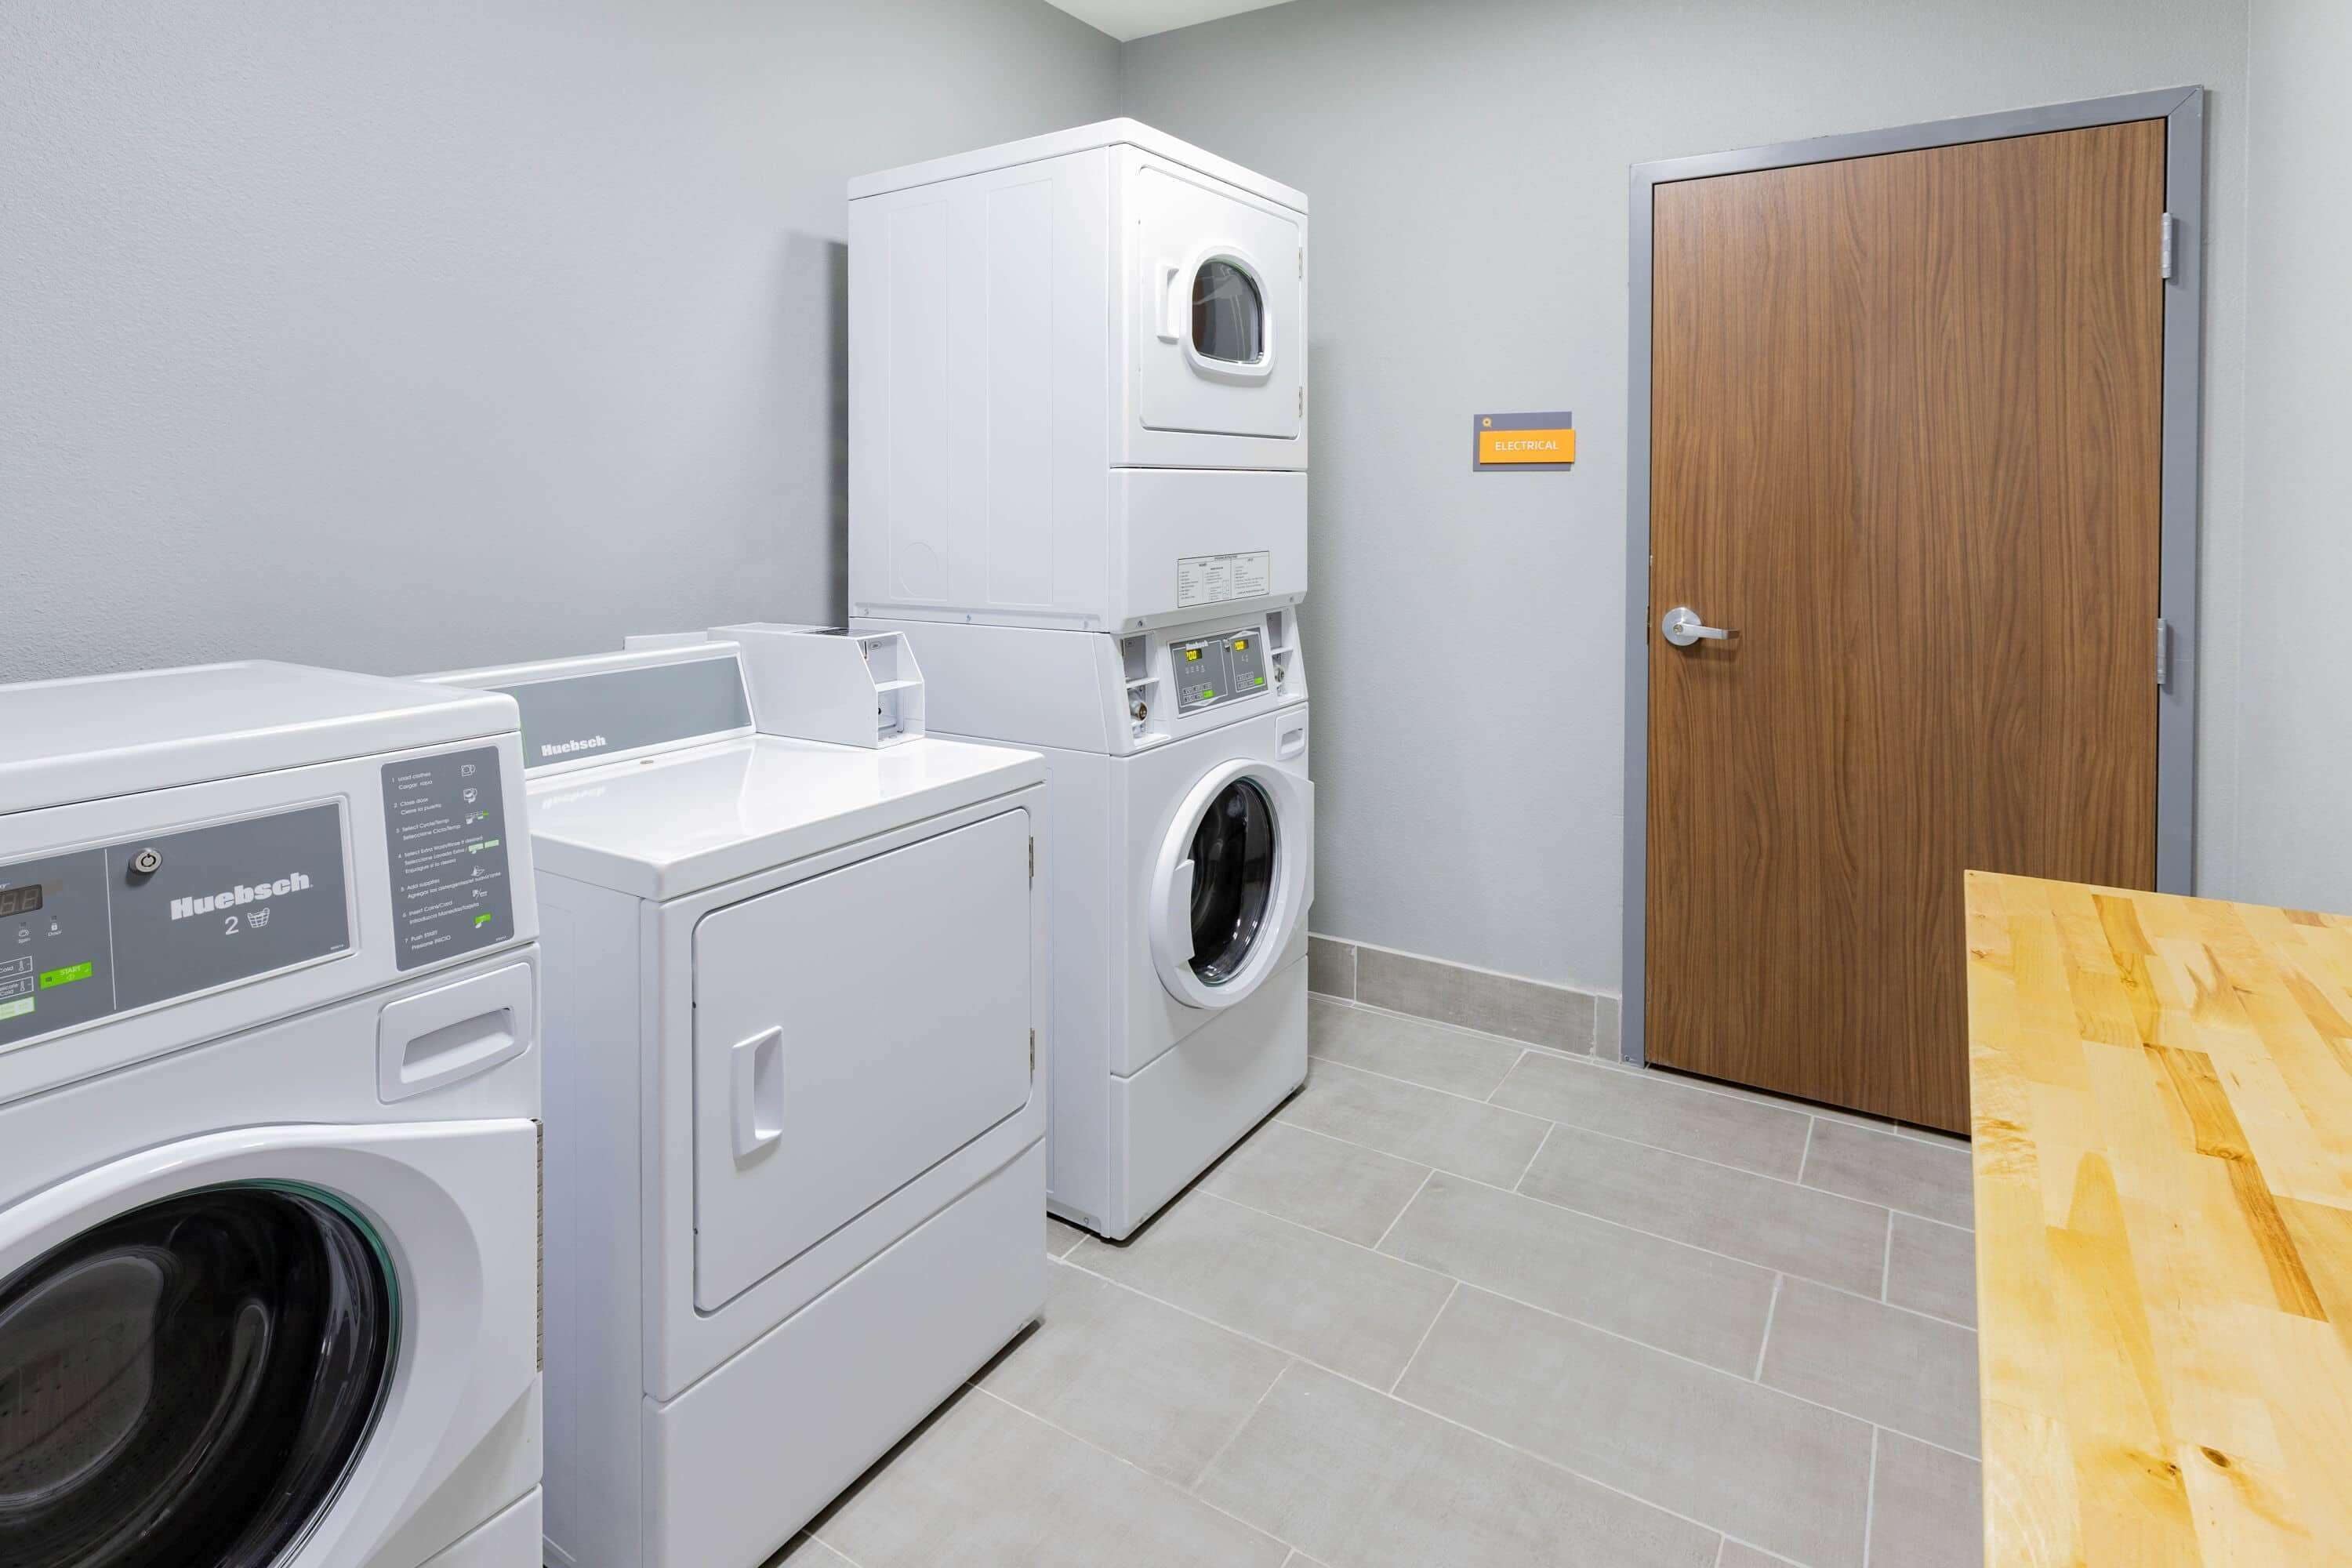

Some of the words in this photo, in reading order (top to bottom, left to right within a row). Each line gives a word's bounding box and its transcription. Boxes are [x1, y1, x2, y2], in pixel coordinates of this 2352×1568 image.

[1495, 441, 1559, 451] ELECTRICAL
[541, 735, 607, 757] Huebsch
[170, 872, 310, 920] Huebsch
[224, 916, 239, 935] 2
